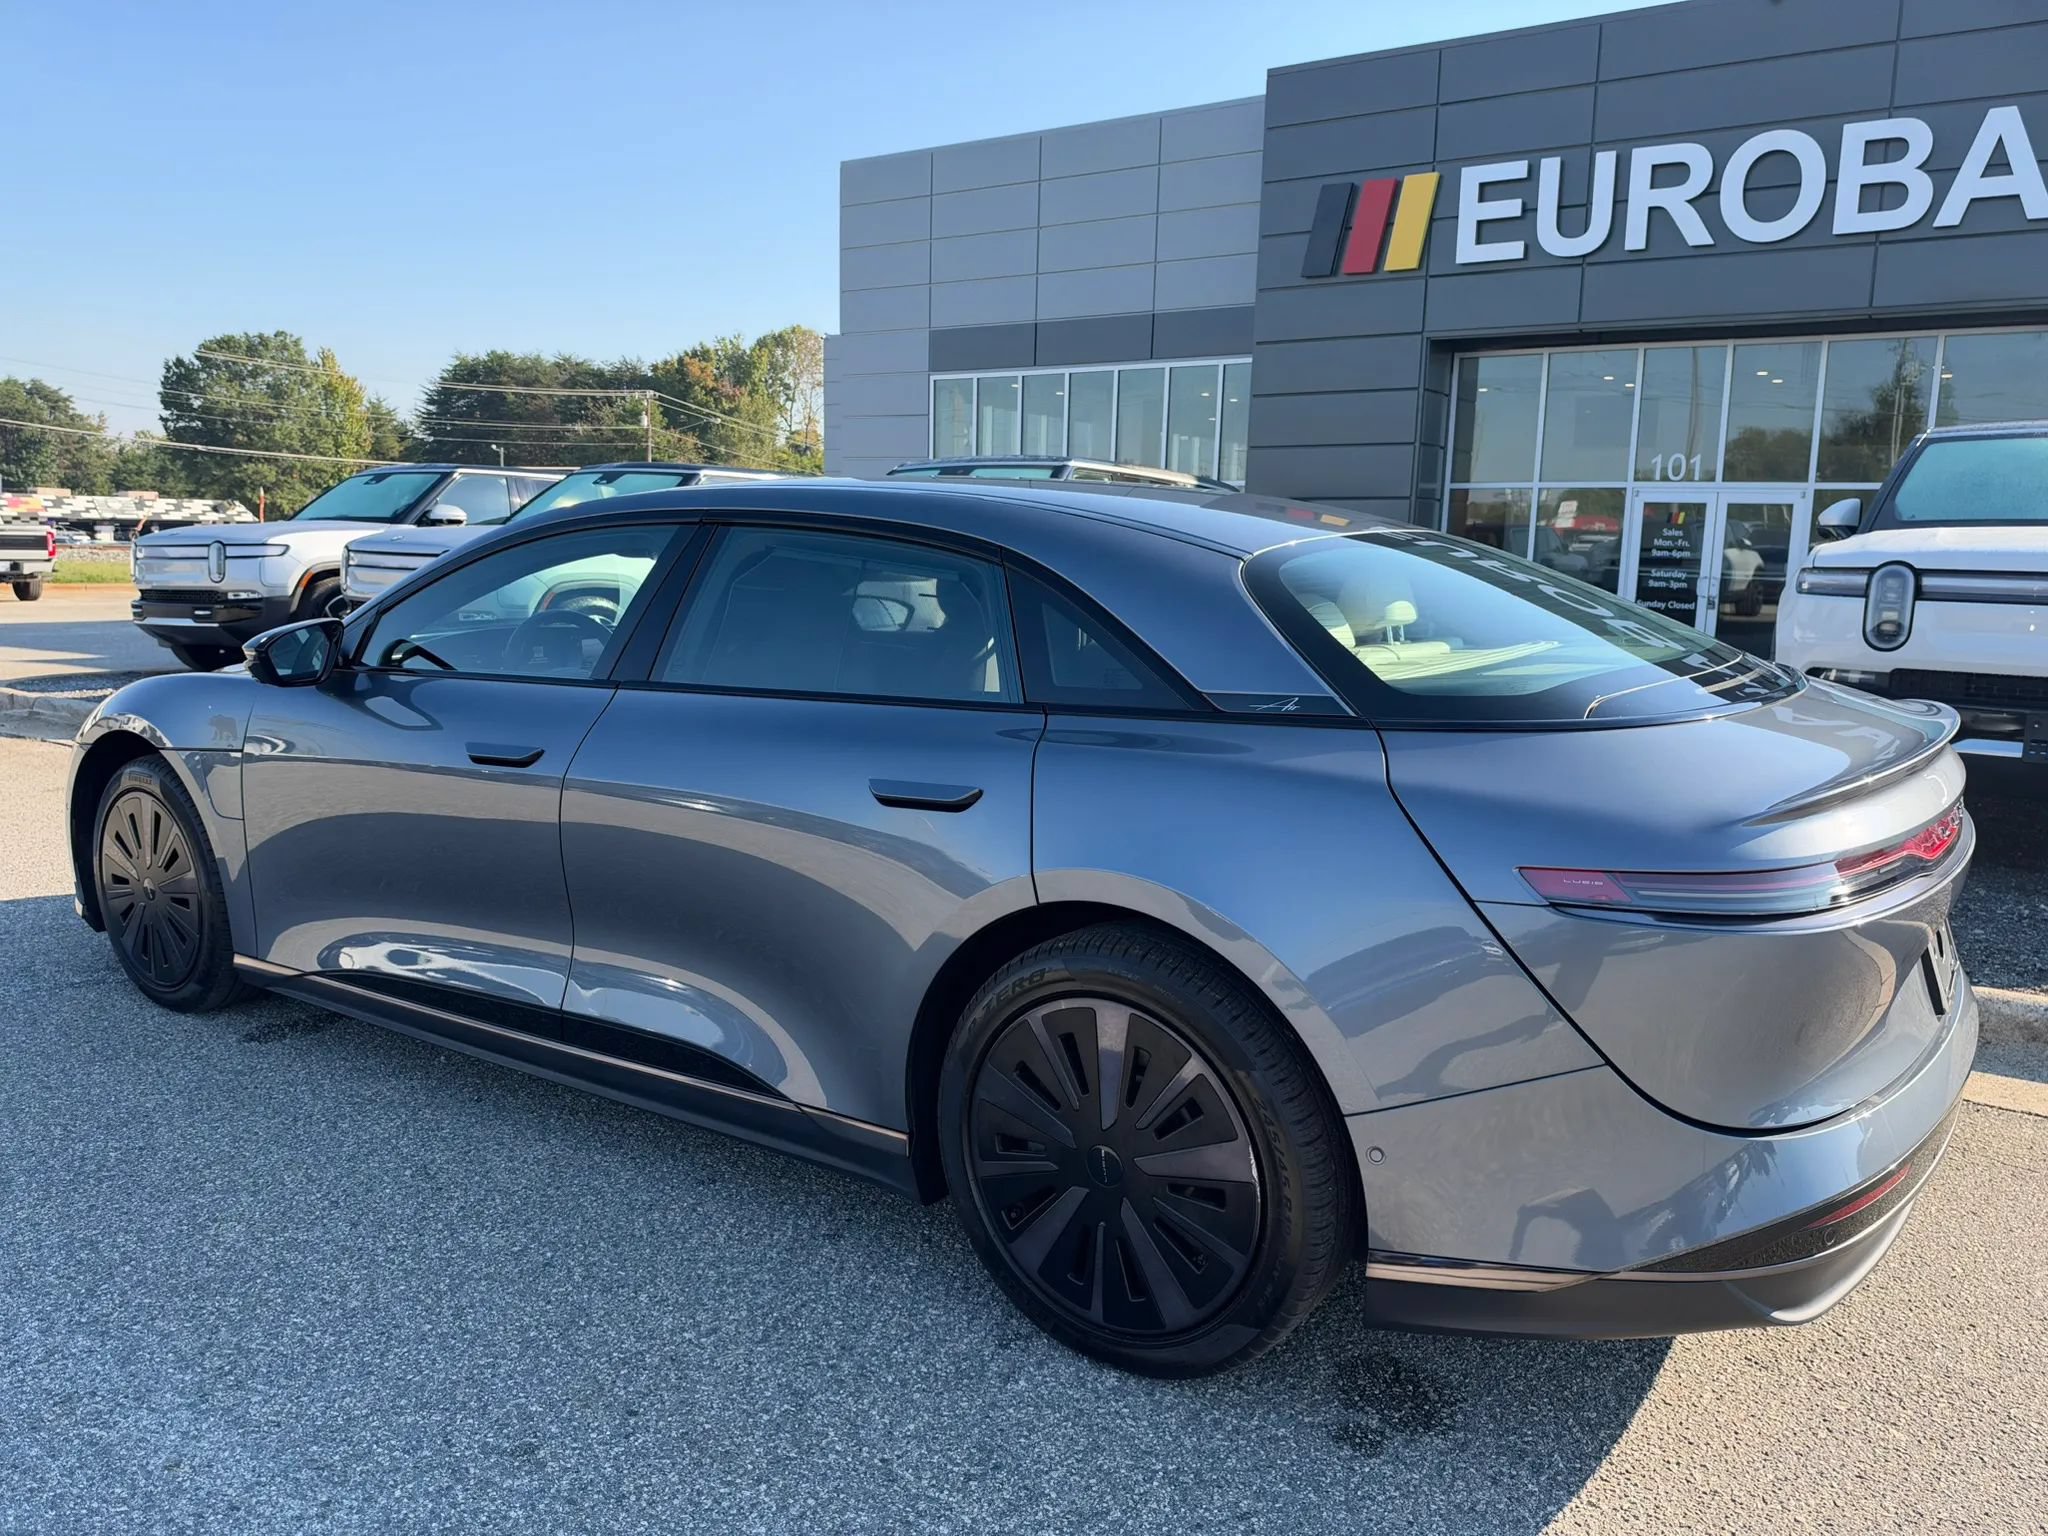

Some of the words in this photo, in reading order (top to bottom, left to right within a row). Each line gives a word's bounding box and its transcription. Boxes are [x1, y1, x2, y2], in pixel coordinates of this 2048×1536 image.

[1651, 453, 1702, 481] 101
[1662, 527, 1684, 537] Sales
[1651, 549, 1691, 559] 9am-6pm
[1650, 569, 1687, 579] Saturday
[1648, 579, 1688, 590] 9am-3pm
[1636, 600, 1667, 610] Sunday
[1667, 600, 1695, 610] Closed
